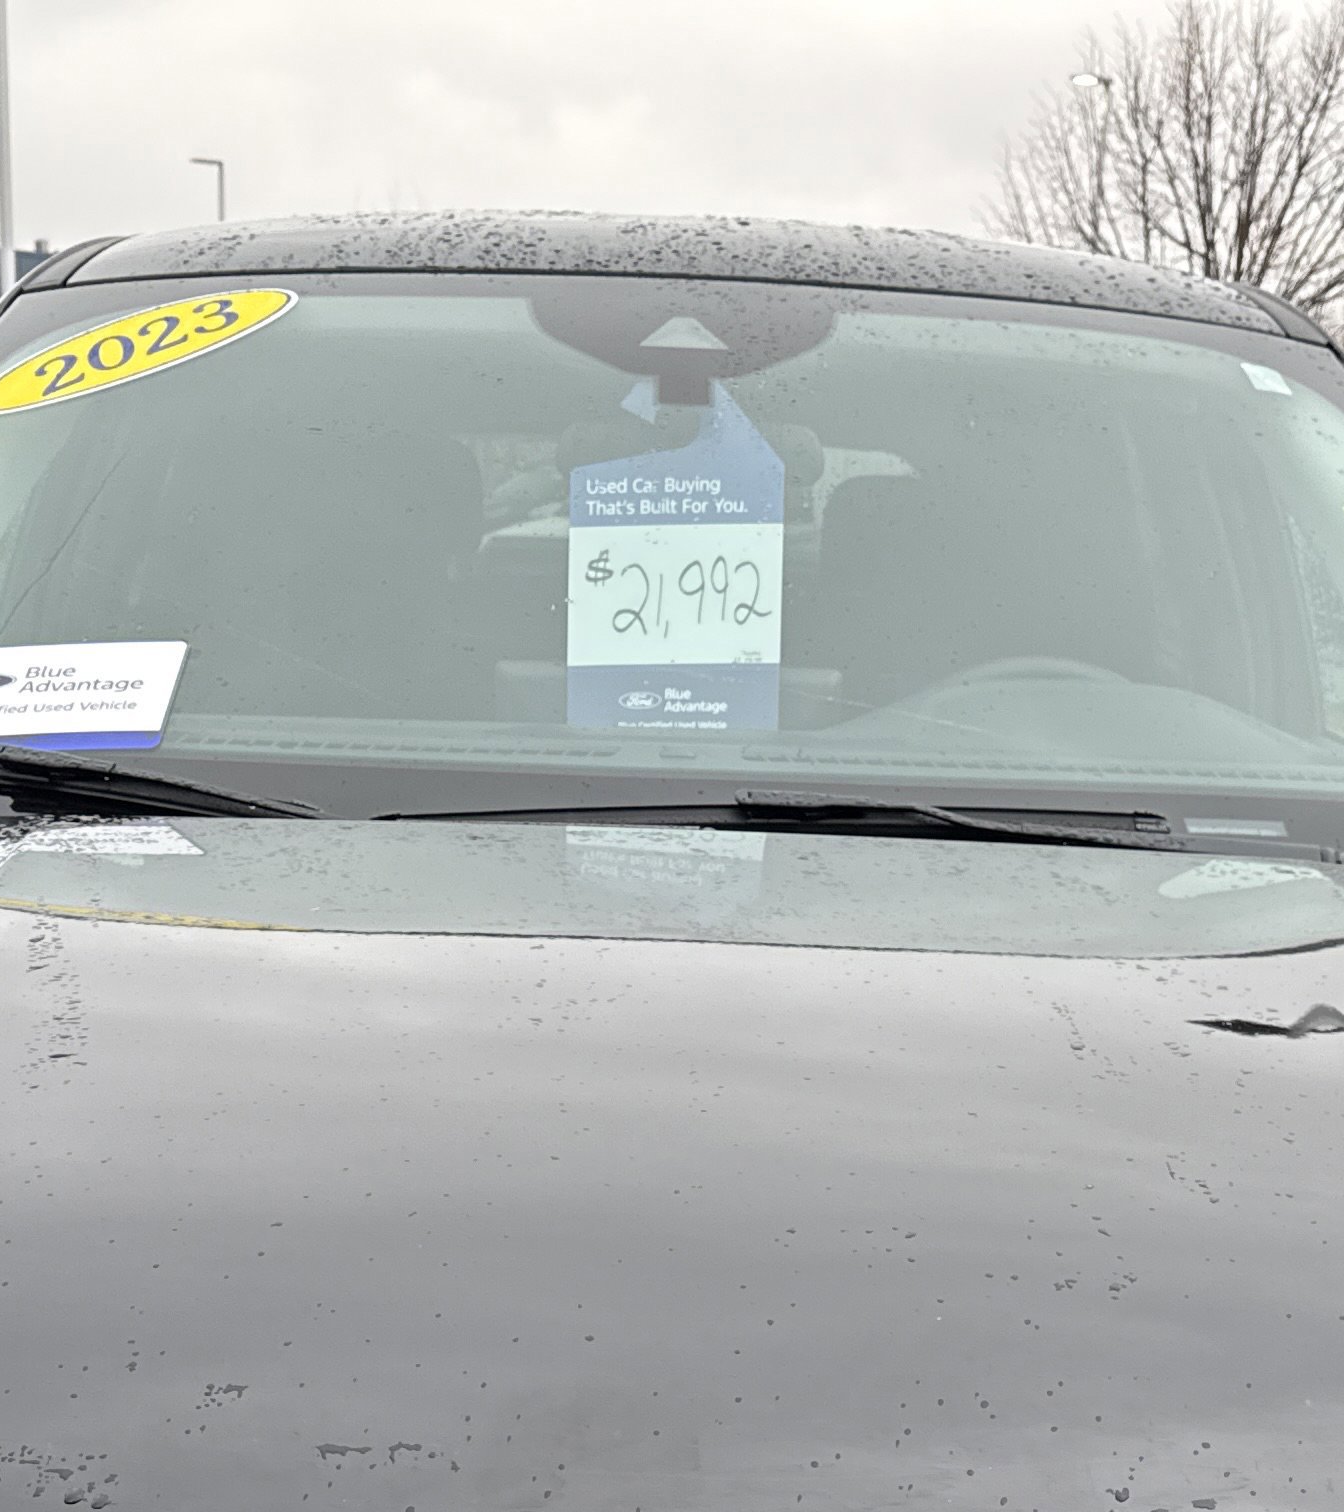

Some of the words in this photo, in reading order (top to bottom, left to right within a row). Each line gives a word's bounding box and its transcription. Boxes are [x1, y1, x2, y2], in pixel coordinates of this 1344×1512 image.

[35, 299, 238, 397] 2023
[585, 478, 628, 495] Used
[664, 475, 721, 496] Buying
[585, 500, 635, 516] That's
[640, 498, 677, 514] Built
[682, 498, 708, 514] For
[714, 498, 749, 514] You.
[26, 666, 76, 678] Blue
[18, 677, 144, 693] Advantage
[664, 687, 692, 700] Blue
[33, 701, 73, 713] Used
[80, 700, 138, 711] Vehicle
[664, 700, 728, 714] Advantage
